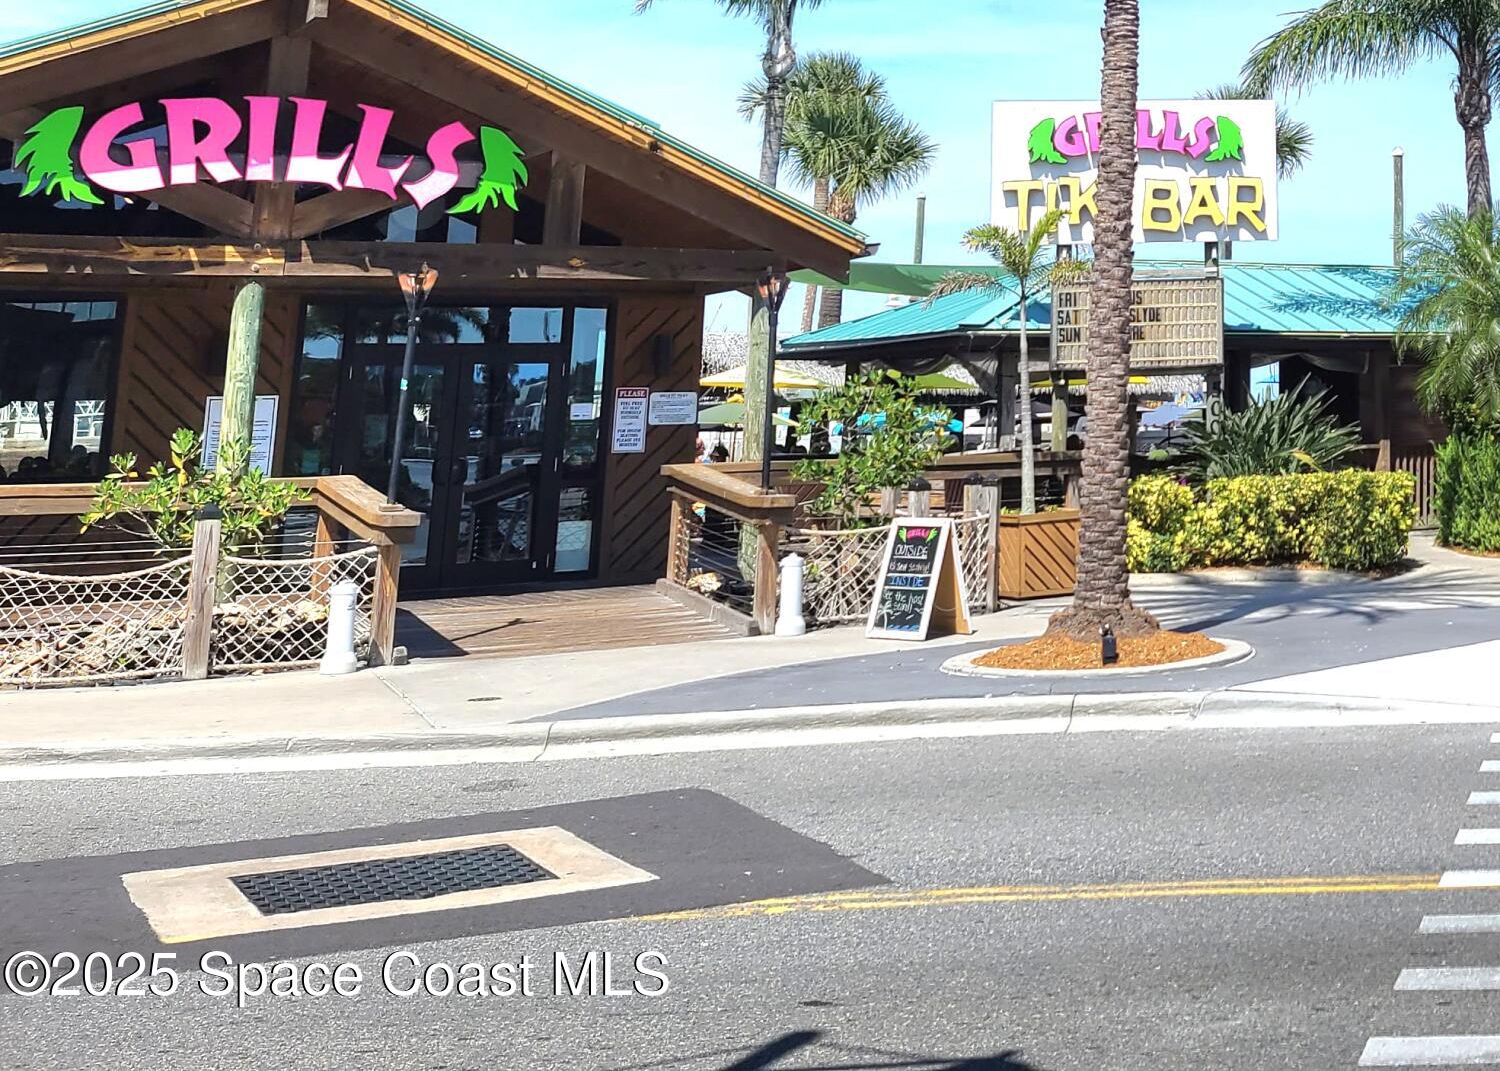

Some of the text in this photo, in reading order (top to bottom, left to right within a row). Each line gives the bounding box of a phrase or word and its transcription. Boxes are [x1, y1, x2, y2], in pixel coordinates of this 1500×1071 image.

[1053, 109, 1216, 159] GLLS
[80, 96, 476, 211] GRILLS
[1002, 176, 1267, 233] TIK BAR
[1059, 292, 1077, 307] FRI
[1057, 310, 1079, 325] SAT
[1058, 327, 1081, 343] SUN
[894, 544, 928, 557] OUTSIDE
[889, 576, 924, 587] INSIDE
